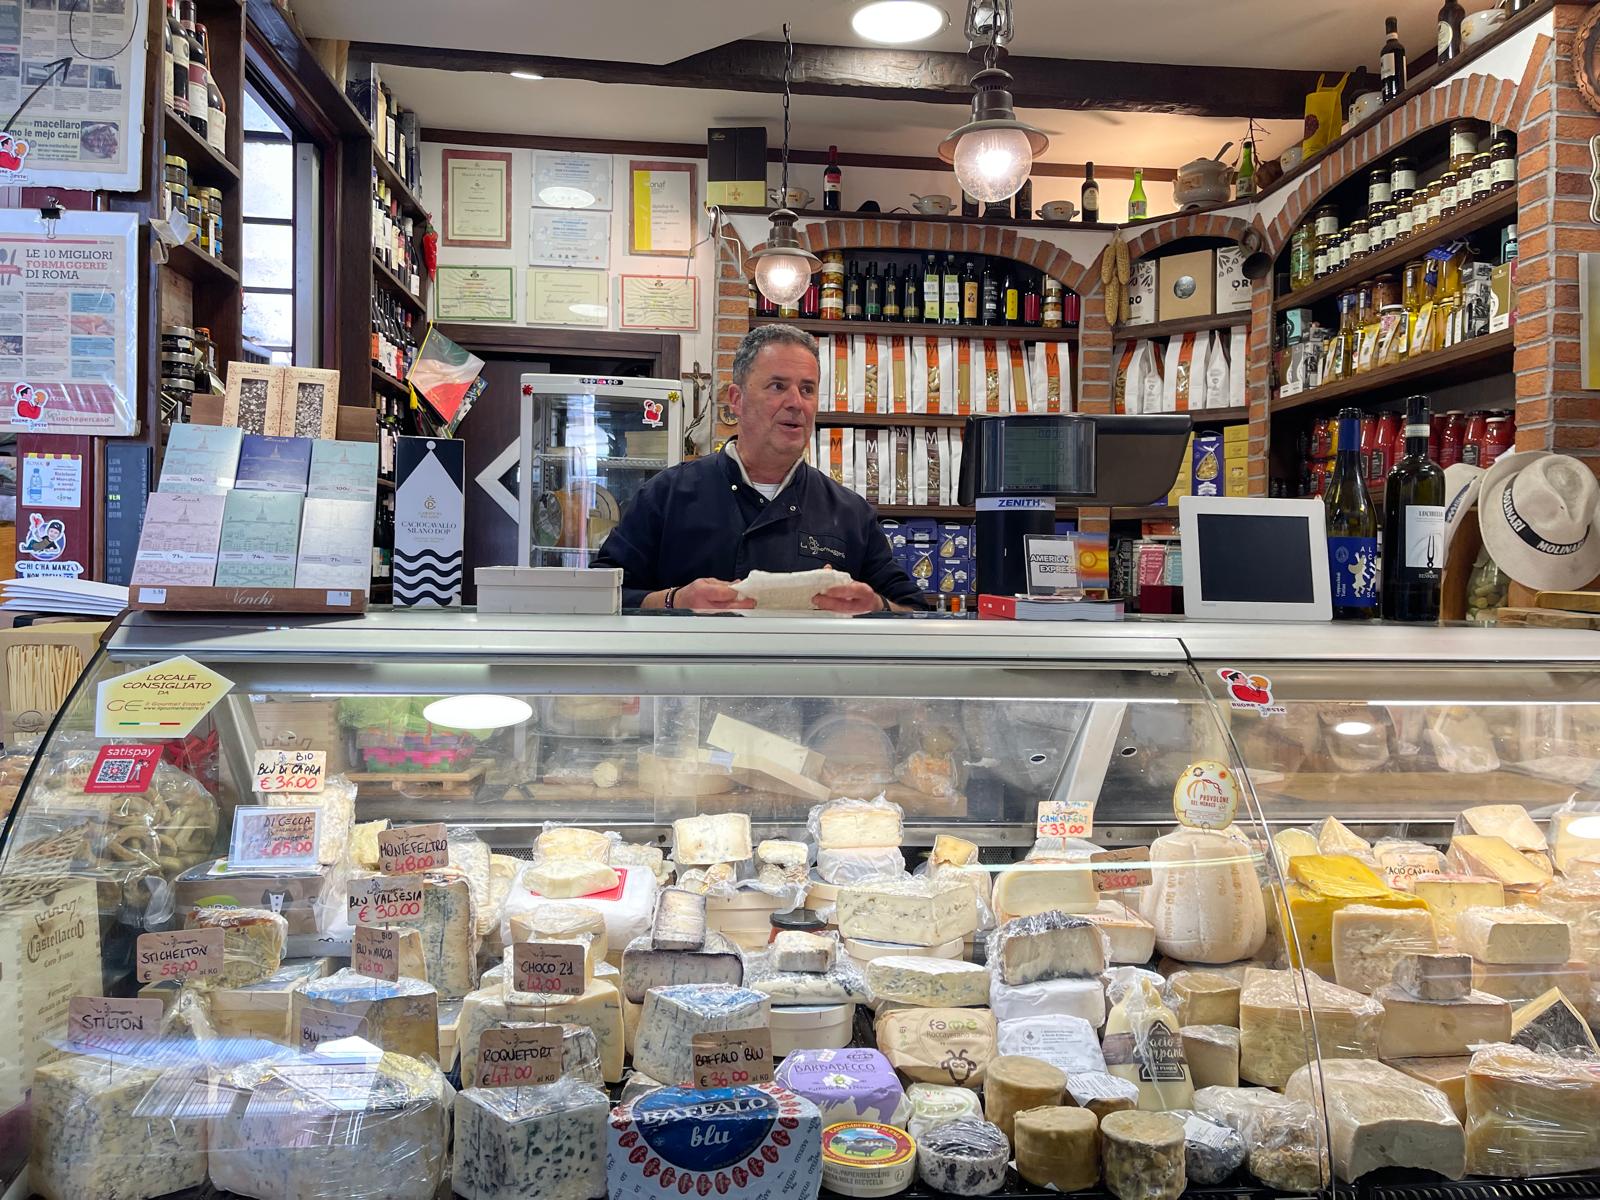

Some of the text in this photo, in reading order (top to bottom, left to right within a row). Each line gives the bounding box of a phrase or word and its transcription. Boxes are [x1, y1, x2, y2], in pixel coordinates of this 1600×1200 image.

[33, 119, 80, 129] macellaro
[24, 129, 80, 140] le mejo carni
[25, 249, 113, 260] LE 10 MIGLIORI
[26, 260, 108, 270] FORMAGGERIE
[25, 269, 80, 280] DI ROMA
[1231, 279, 1252, 288] OR
[997, 499, 1041, 508] ZENITH
[1503, 487, 1526, 533] MOLINARI
[401, 521, 457, 530] CACIOCAVALLO
[407, 527, 434, 535] SILANO
[1029, 554, 1073, 563] AMERICAN
[17, 562, 34, 570] CHI
[1039, 565, 1078, 574] EXPRESS
[225, 589, 274, 607] Venchi
[106, 747, 155, 758] satispay
[296, 752, 314, 761] BIO
[291, 764, 321, 776] CAPRA
[260, 776, 272, 790] €
[380, 839, 448, 858] MONTEFELTRO
[385, 862, 392, 872] €
[1097, 882, 1105, 891] €
[349, 890, 422, 908] BLU VALSESIA
[358, 902, 420, 923] € 30.00
[27, 919, 85, 963] Castellaccio
[381, 932, 393, 940] BIO
[356, 943, 367, 955] BLU
[141, 945, 209, 965] STICHELTON
[521, 960, 556, 974] CHOCO
[143, 970, 152, 980] €
[518, 983, 525, 991] €
[82, 1012, 145, 1032] STILTON
[483, 1046, 555, 1063] ROQUEFORT
[744, 1047, 764, 1062] BLU
[482, 1073, 491, 1086] €
[699, 1075, 708, 1088] €
[710, 1071, 749, 1087] 36.00
[690, 1124, 734, 1148] blu
